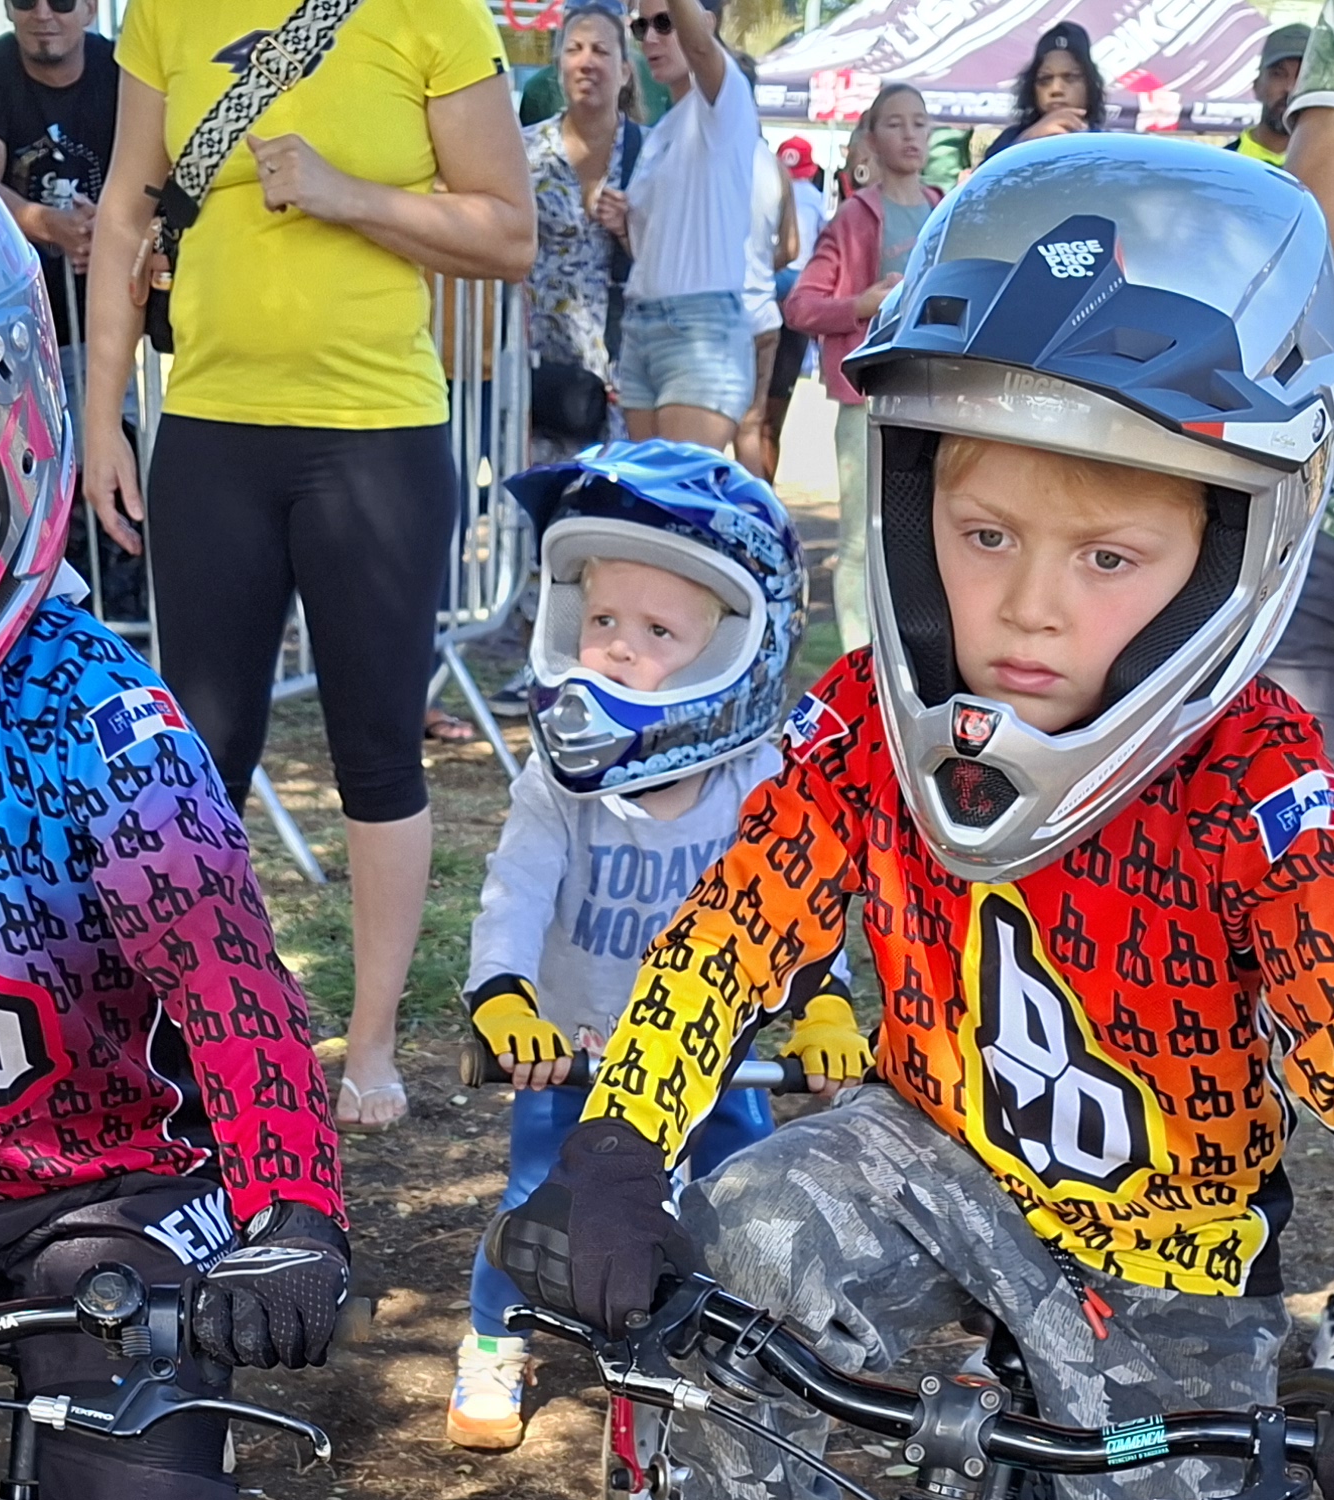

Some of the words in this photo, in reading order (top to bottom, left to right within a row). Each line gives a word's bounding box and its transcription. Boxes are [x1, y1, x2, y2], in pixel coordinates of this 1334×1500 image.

[1037, 239, 1104, 257] URGE
[1045, 252, 1095, 269] PRO
[1051, 264, 1094, 279] CO.
[570, 899, 680, 961] MOO
[70, 1405, 115, 1422] TEKTRO
[1105, 1429, 1167, 1455] COMMENCAL
